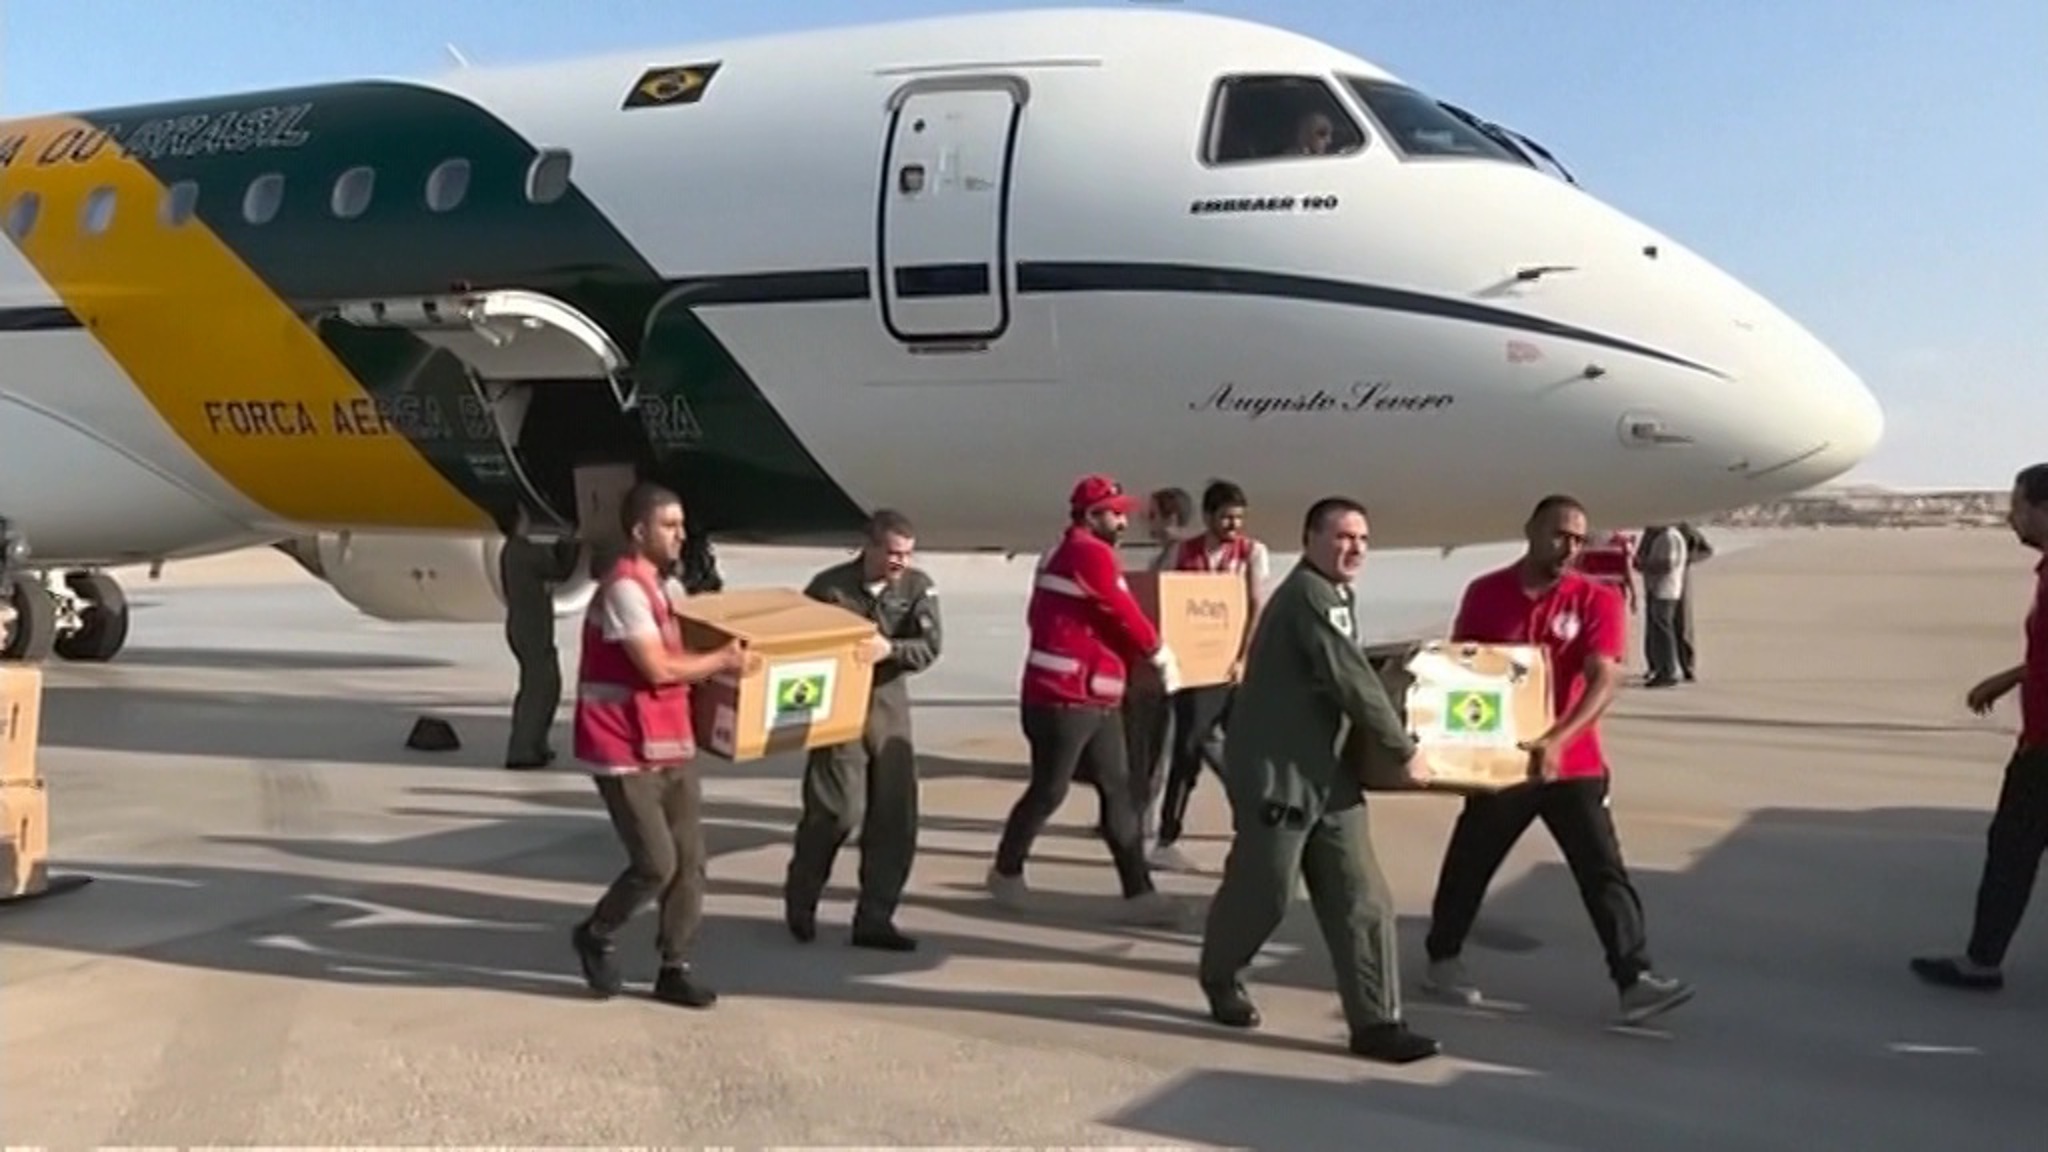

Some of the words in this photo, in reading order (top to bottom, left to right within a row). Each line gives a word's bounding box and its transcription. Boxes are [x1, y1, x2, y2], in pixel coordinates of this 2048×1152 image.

[37, 124, 120, 165] DO
[122, 102, 313, 160] BRASIL
[1189, 381, 1336, 420] Augusto
